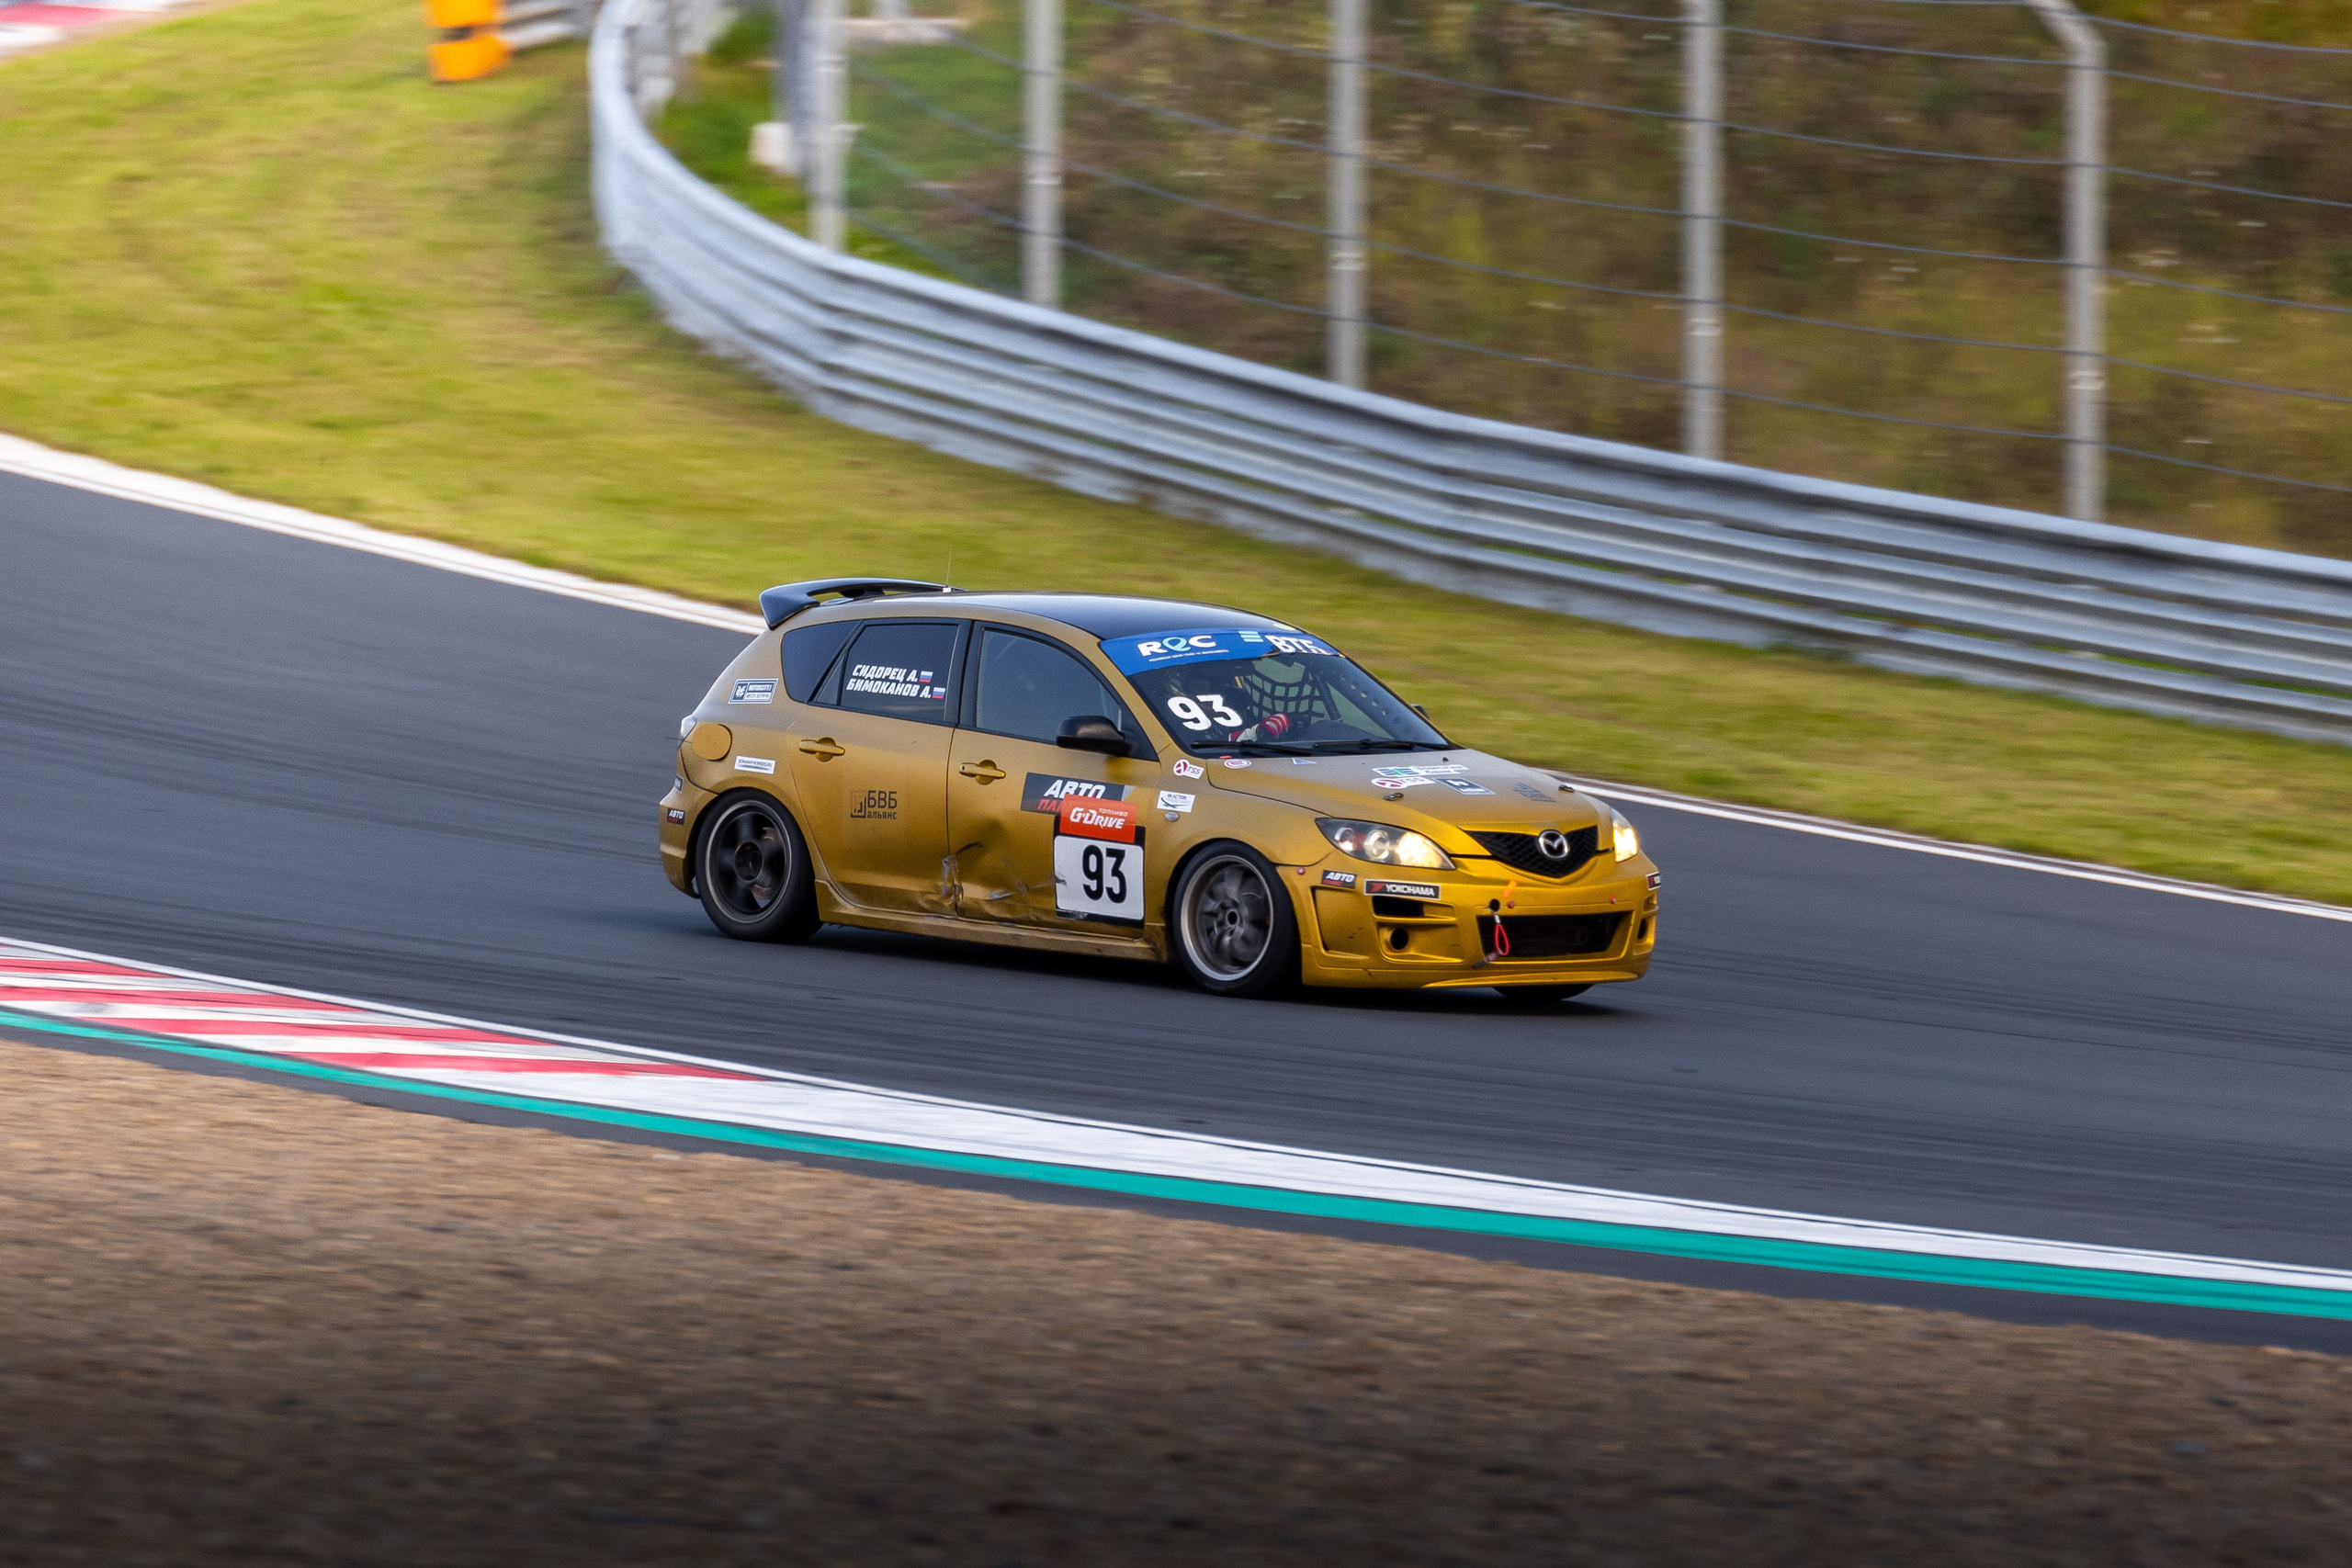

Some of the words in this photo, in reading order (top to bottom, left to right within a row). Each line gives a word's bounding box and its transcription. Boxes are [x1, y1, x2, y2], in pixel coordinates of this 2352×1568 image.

[852, 664, 907, 682] СИДОРЕЦ
[906, 670, 918, 682] А.
[845, 678, 920, 697] БИМОКАНОВ
[919, 685, 932, 698] А.
[1167, 694, 1243, 731] 93
[867, 790, 898, 809] БВБ
[867, 810, 897, 819] альянс
[1082, 844, 1127, 904] 93
[1325, 872, 1355, 883] АВТО
[1385, 884, 1435, 897] YOKOHAMA
